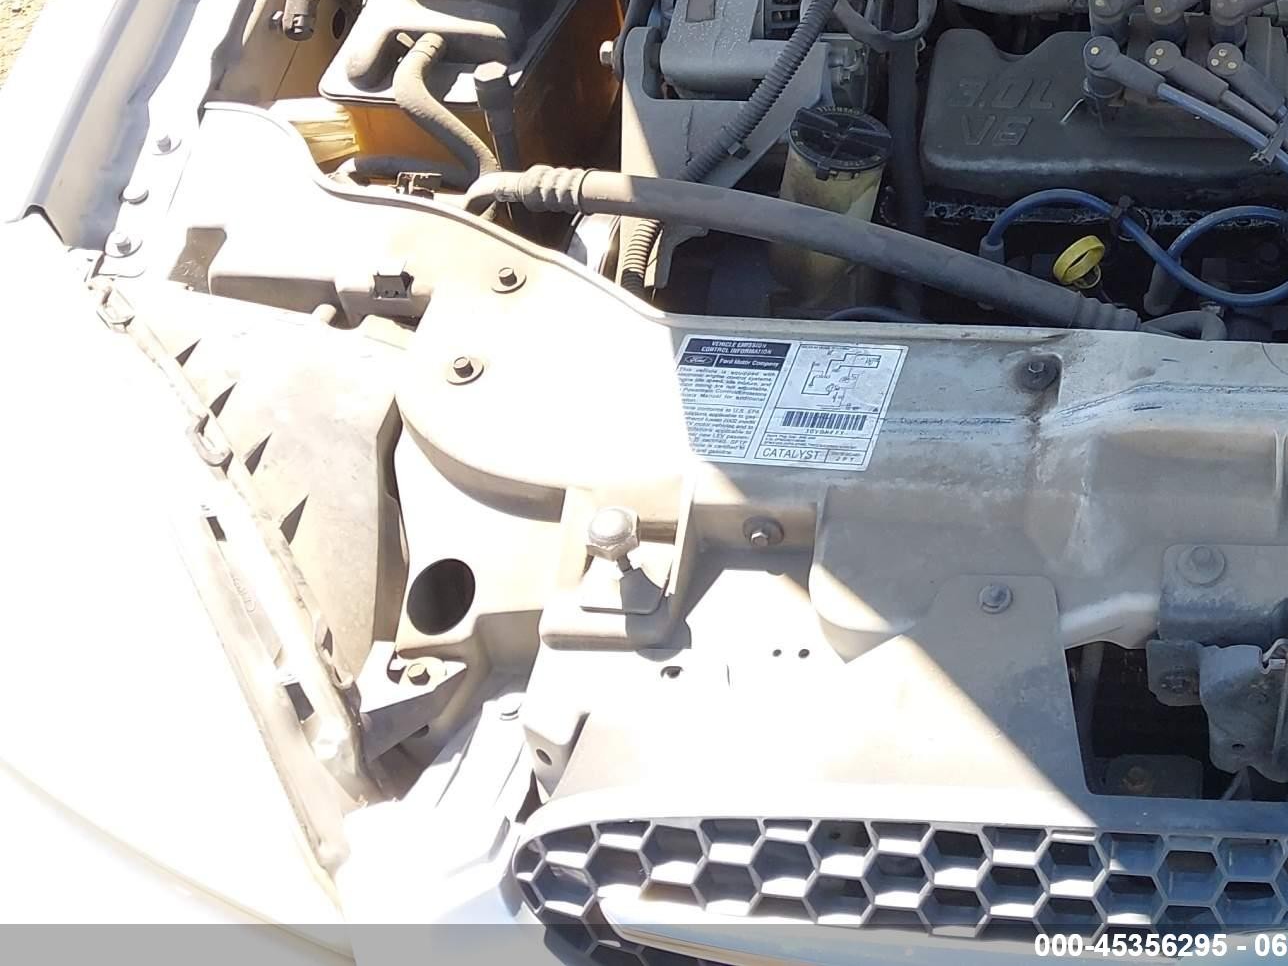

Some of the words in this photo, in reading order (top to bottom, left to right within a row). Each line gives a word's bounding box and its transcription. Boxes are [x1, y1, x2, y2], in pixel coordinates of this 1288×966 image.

[949, 77, 1055, 108] 3.0L
[960, 113, 1034, 147] V6
[752, 360, 780, 368] Company
[762, 447, 821, 460] CATALYST
